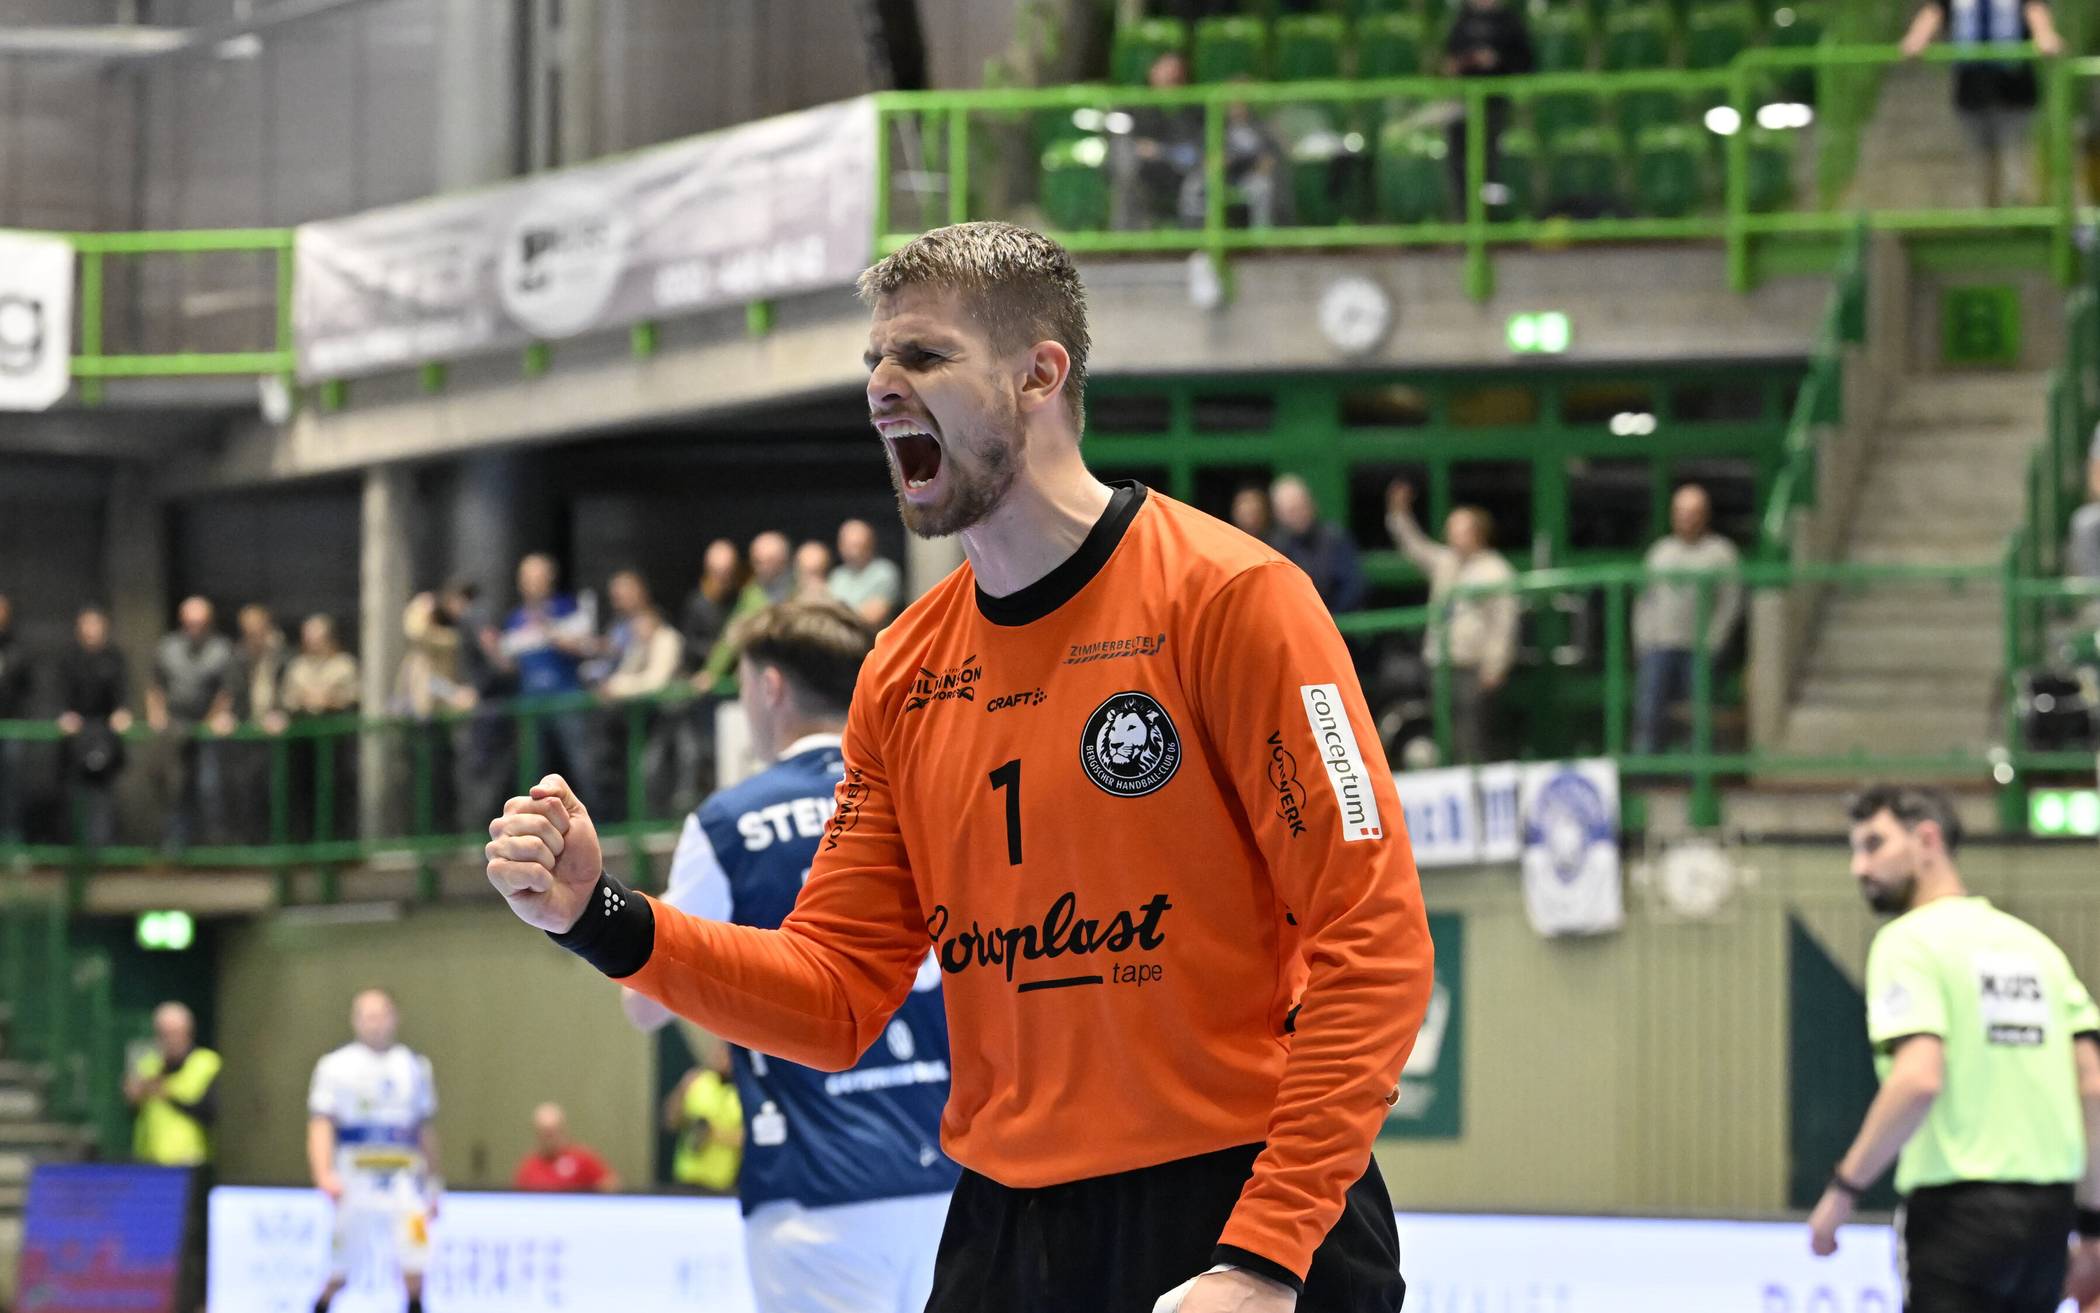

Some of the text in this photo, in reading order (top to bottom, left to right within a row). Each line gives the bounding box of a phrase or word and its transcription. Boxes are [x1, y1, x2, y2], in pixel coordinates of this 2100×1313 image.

[987, 692, 1033, 712] CRAFT
[1085, 742, 1176, 790] BERGISCHER HANDBALL-CLUB 06
[1310, 688, 1366, 825] conceptum
[988, 758, 1022, 866] 1
[1113, 962, 1163, 987] tape
